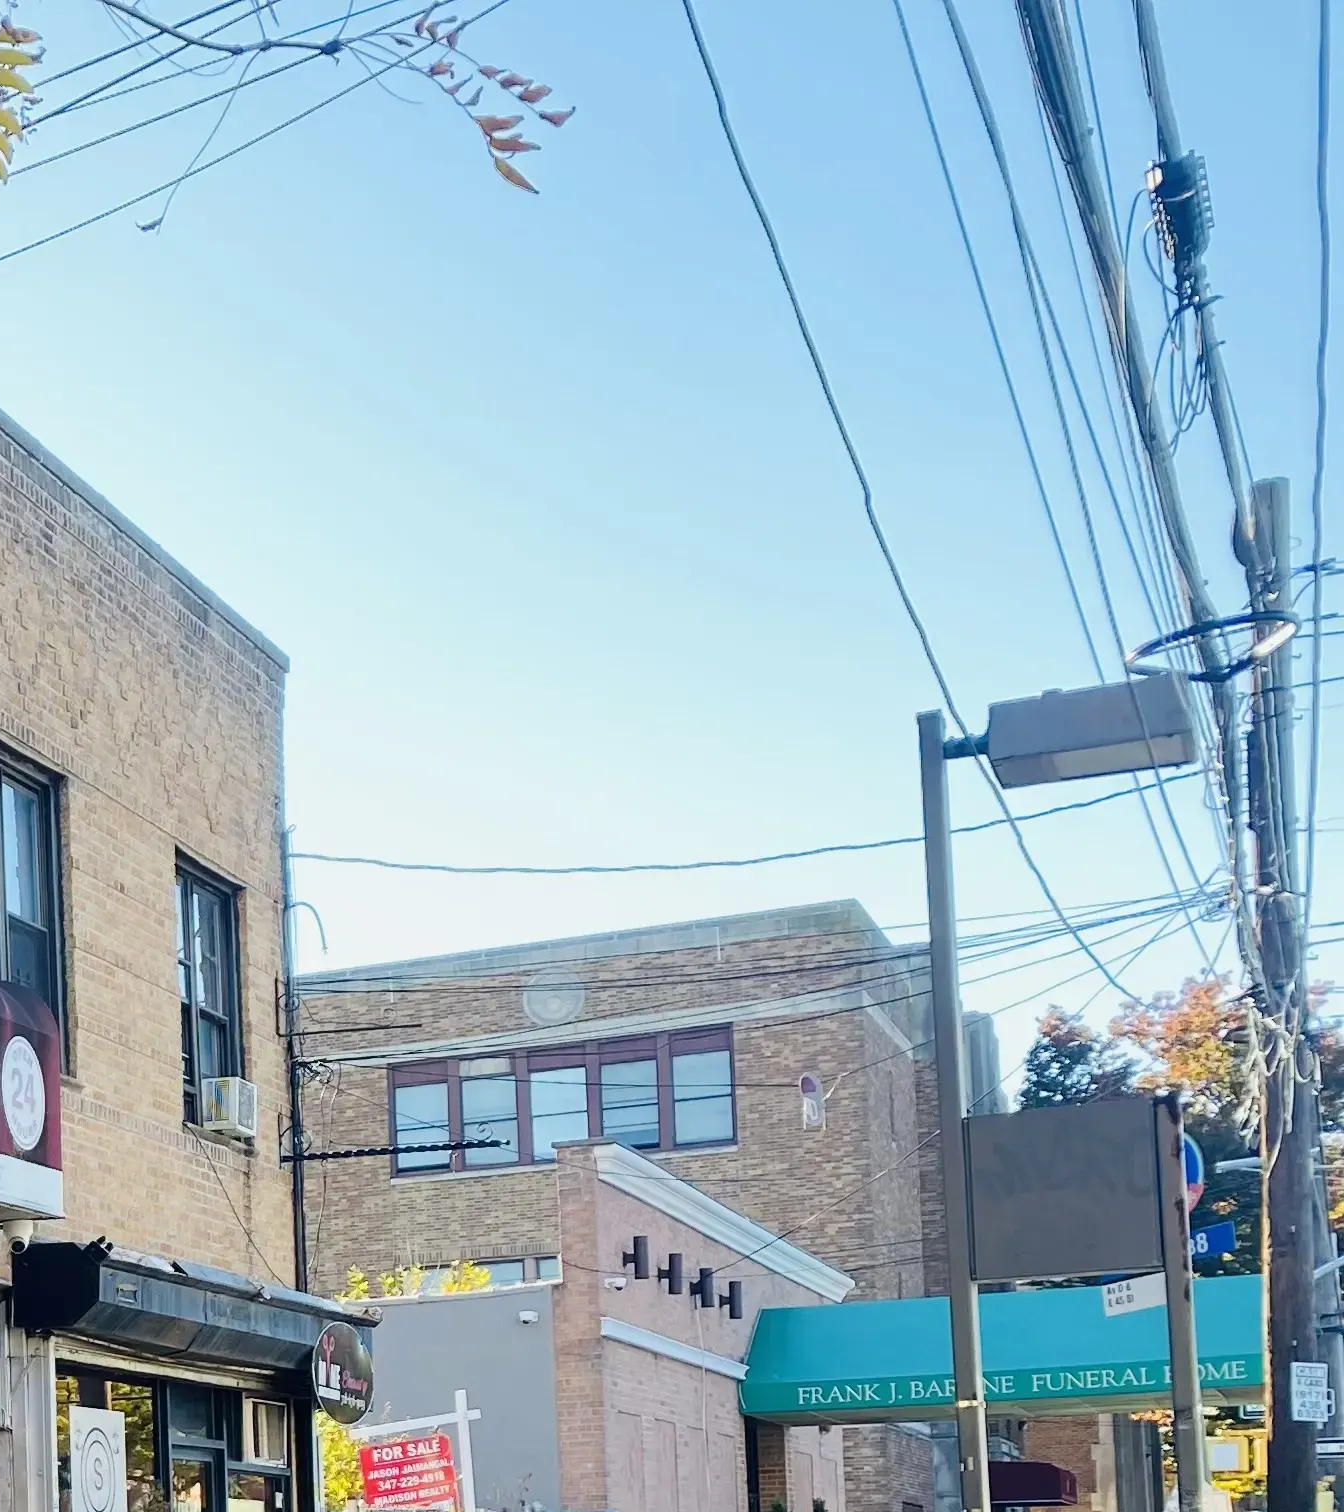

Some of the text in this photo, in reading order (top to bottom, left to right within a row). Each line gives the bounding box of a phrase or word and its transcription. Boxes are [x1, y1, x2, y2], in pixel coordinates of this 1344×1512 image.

[12, 1067, 36, 1114] 24
[797, 1383, 880, 1405] FRANK
[888, 1384, 903, 1404] J.
[909, 1376, 1016, 1399] BARNE
[1031, 1367, 1156, 1392] FUNERAL
[372, 1439, 442, 1462] FOR SALE
[93, 1457, 104, 1491] S
[368, 1467, 400, 1480] JASON
[373, 1484, 451, 1507] MADISON REALTY
